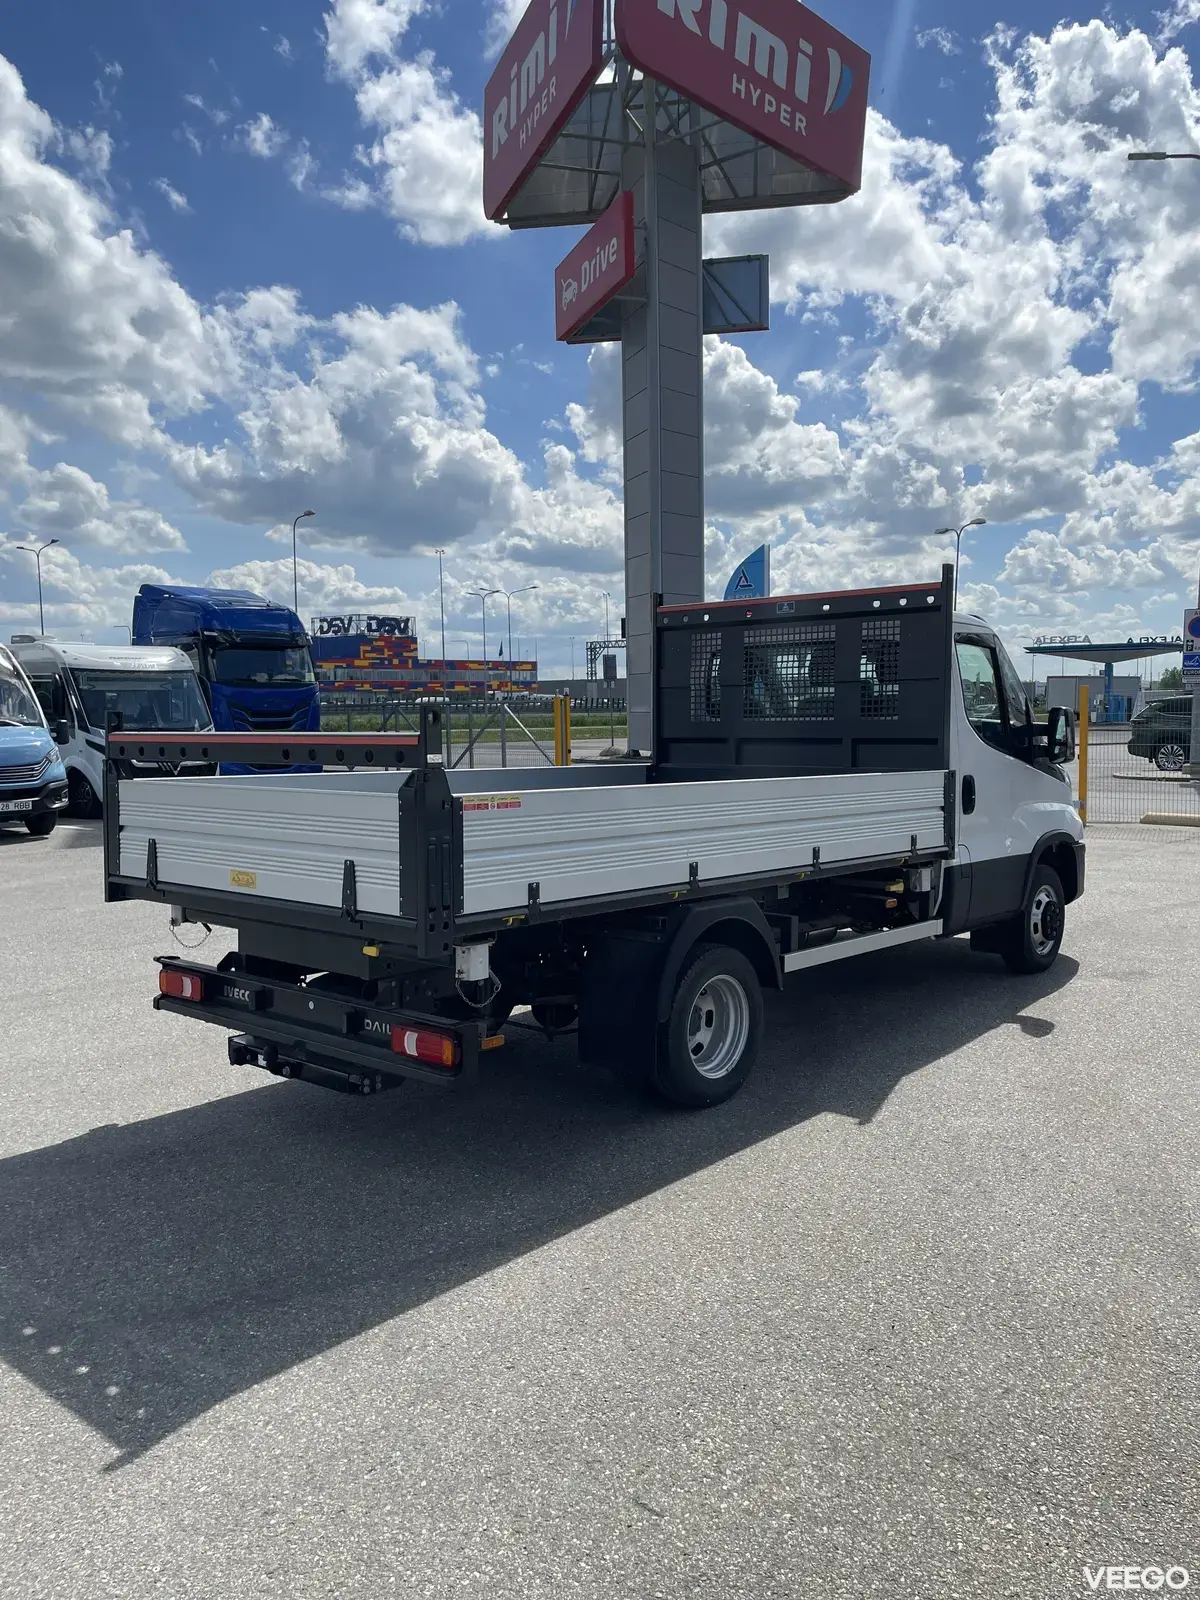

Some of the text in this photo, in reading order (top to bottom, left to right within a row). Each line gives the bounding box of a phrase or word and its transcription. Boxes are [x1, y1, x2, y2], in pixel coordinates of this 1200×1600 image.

[492, 0, 558, 160] Rimi
[732, 73, 808, 137] HYPER
[519, 75, 557, 150] HYPER
[581, 236, 618, 293] Drive
[319, 615, 353, 635] DSV
[367, 615, 411, 634] DSV
[14, 801, 31, 810] RBB
